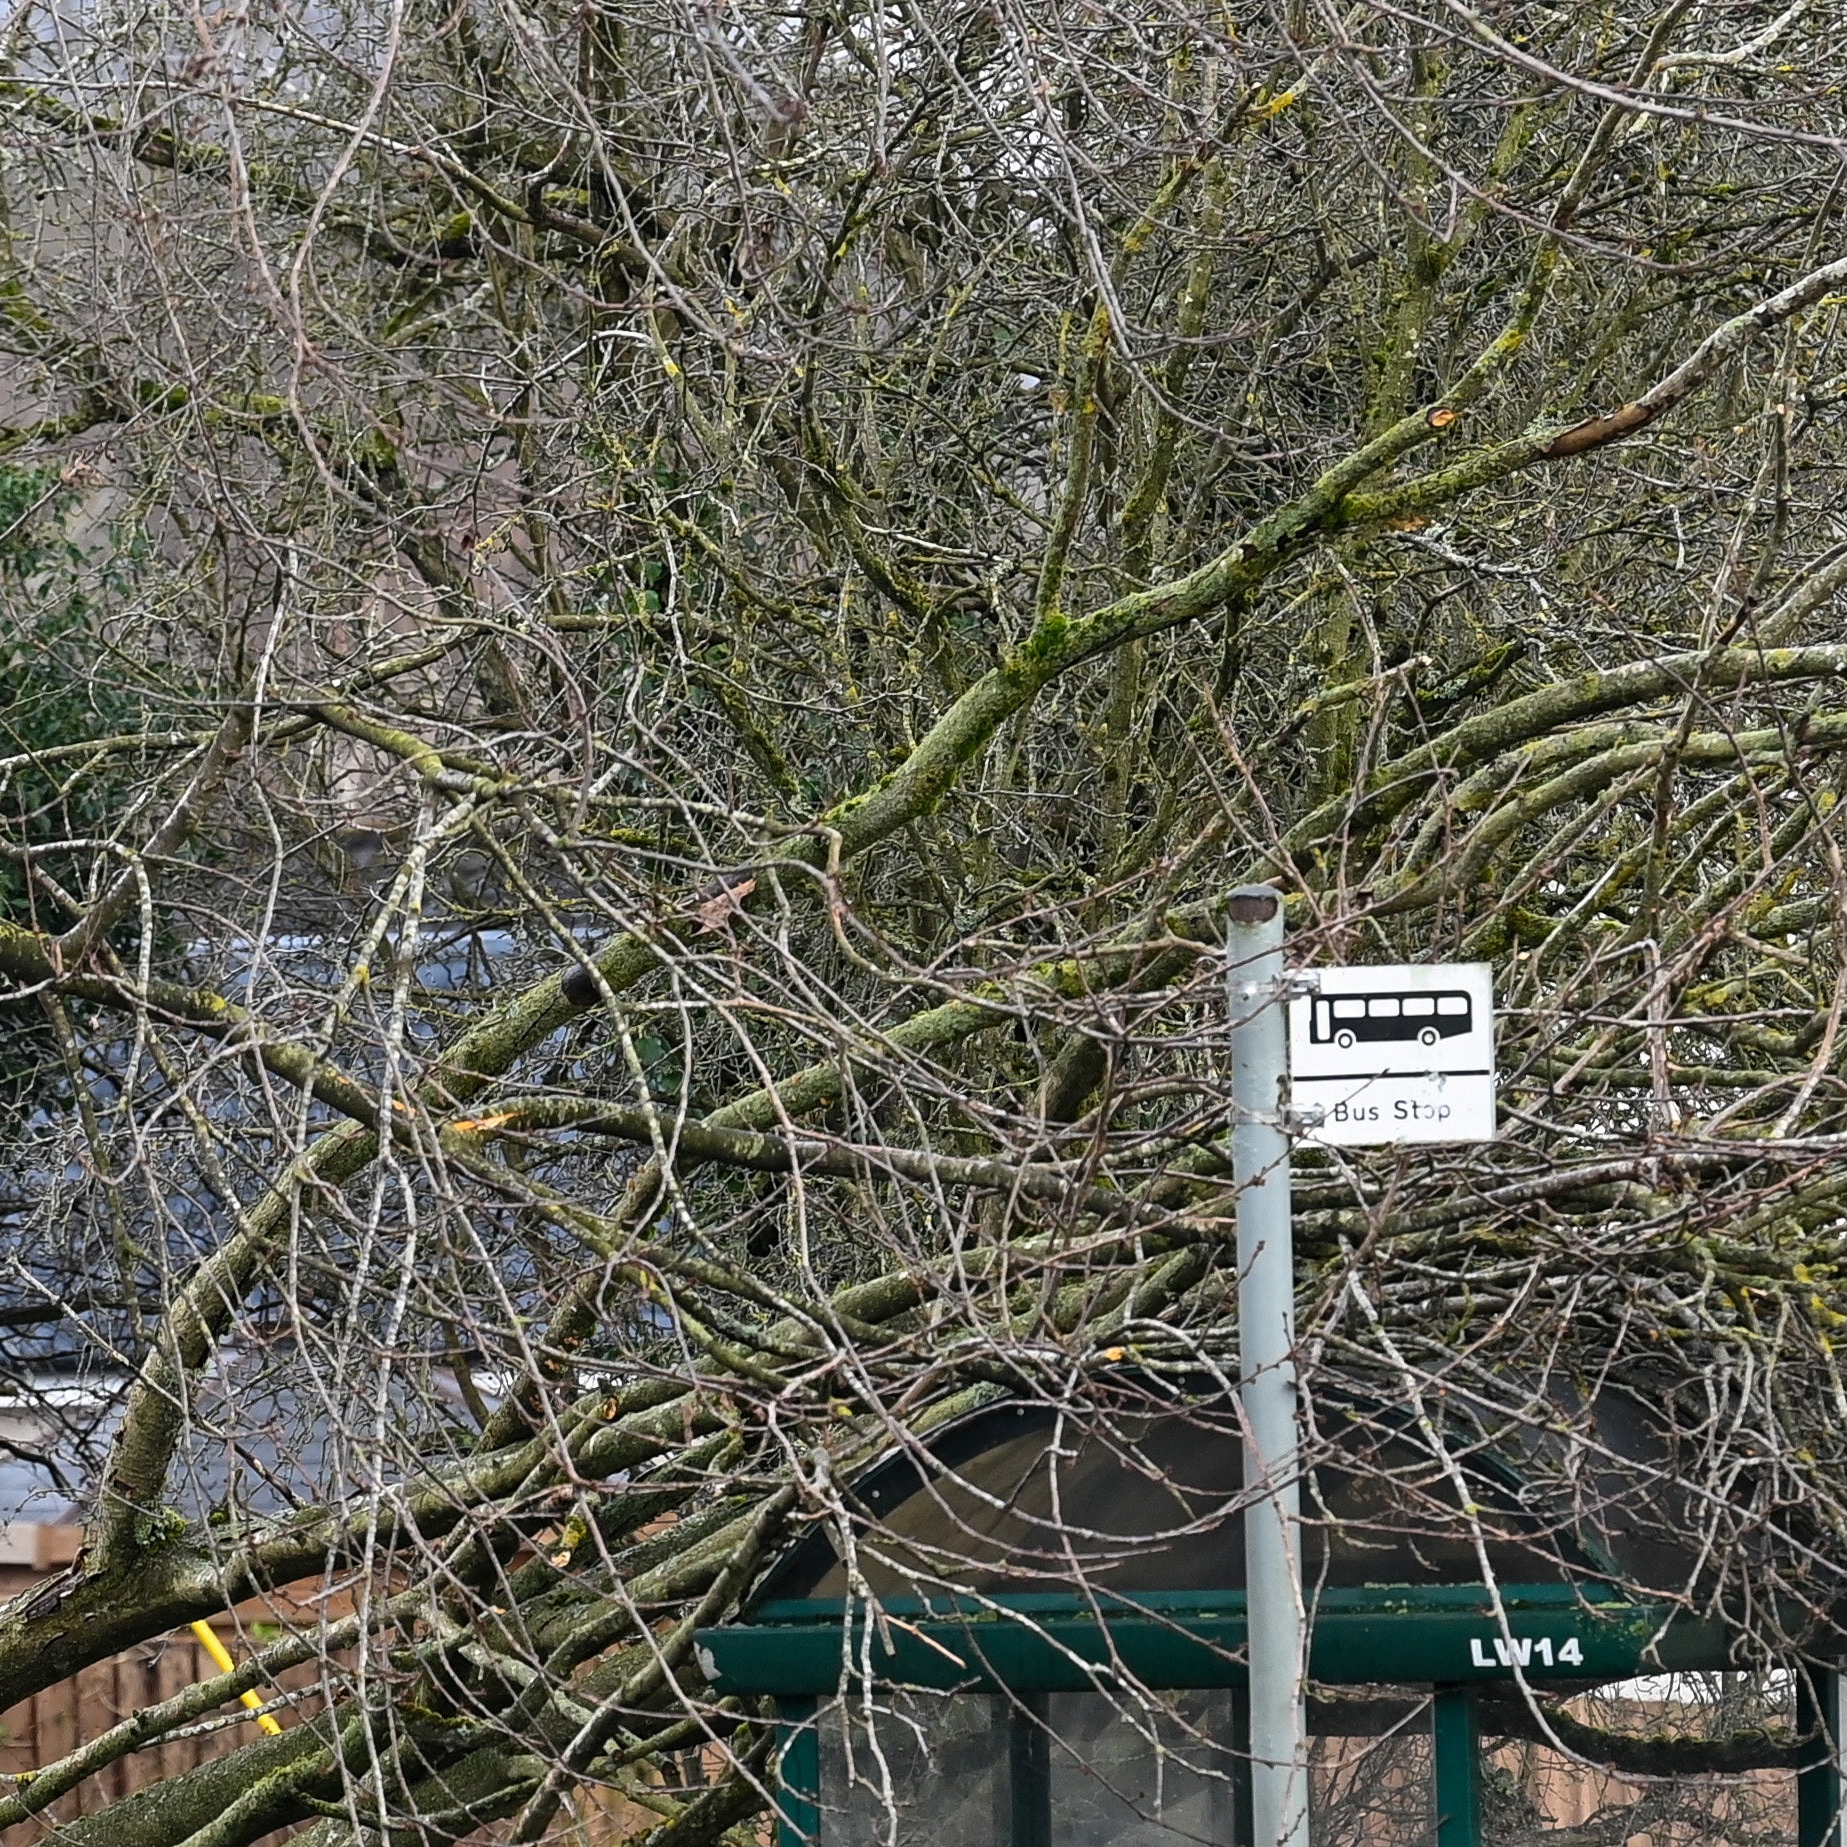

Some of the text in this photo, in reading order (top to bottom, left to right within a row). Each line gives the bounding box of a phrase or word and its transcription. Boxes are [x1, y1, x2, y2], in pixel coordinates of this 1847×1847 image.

[1335, 1100, 1451, 1122] Bus Stop
[1470, 1637, 1584, 1668] LW14
